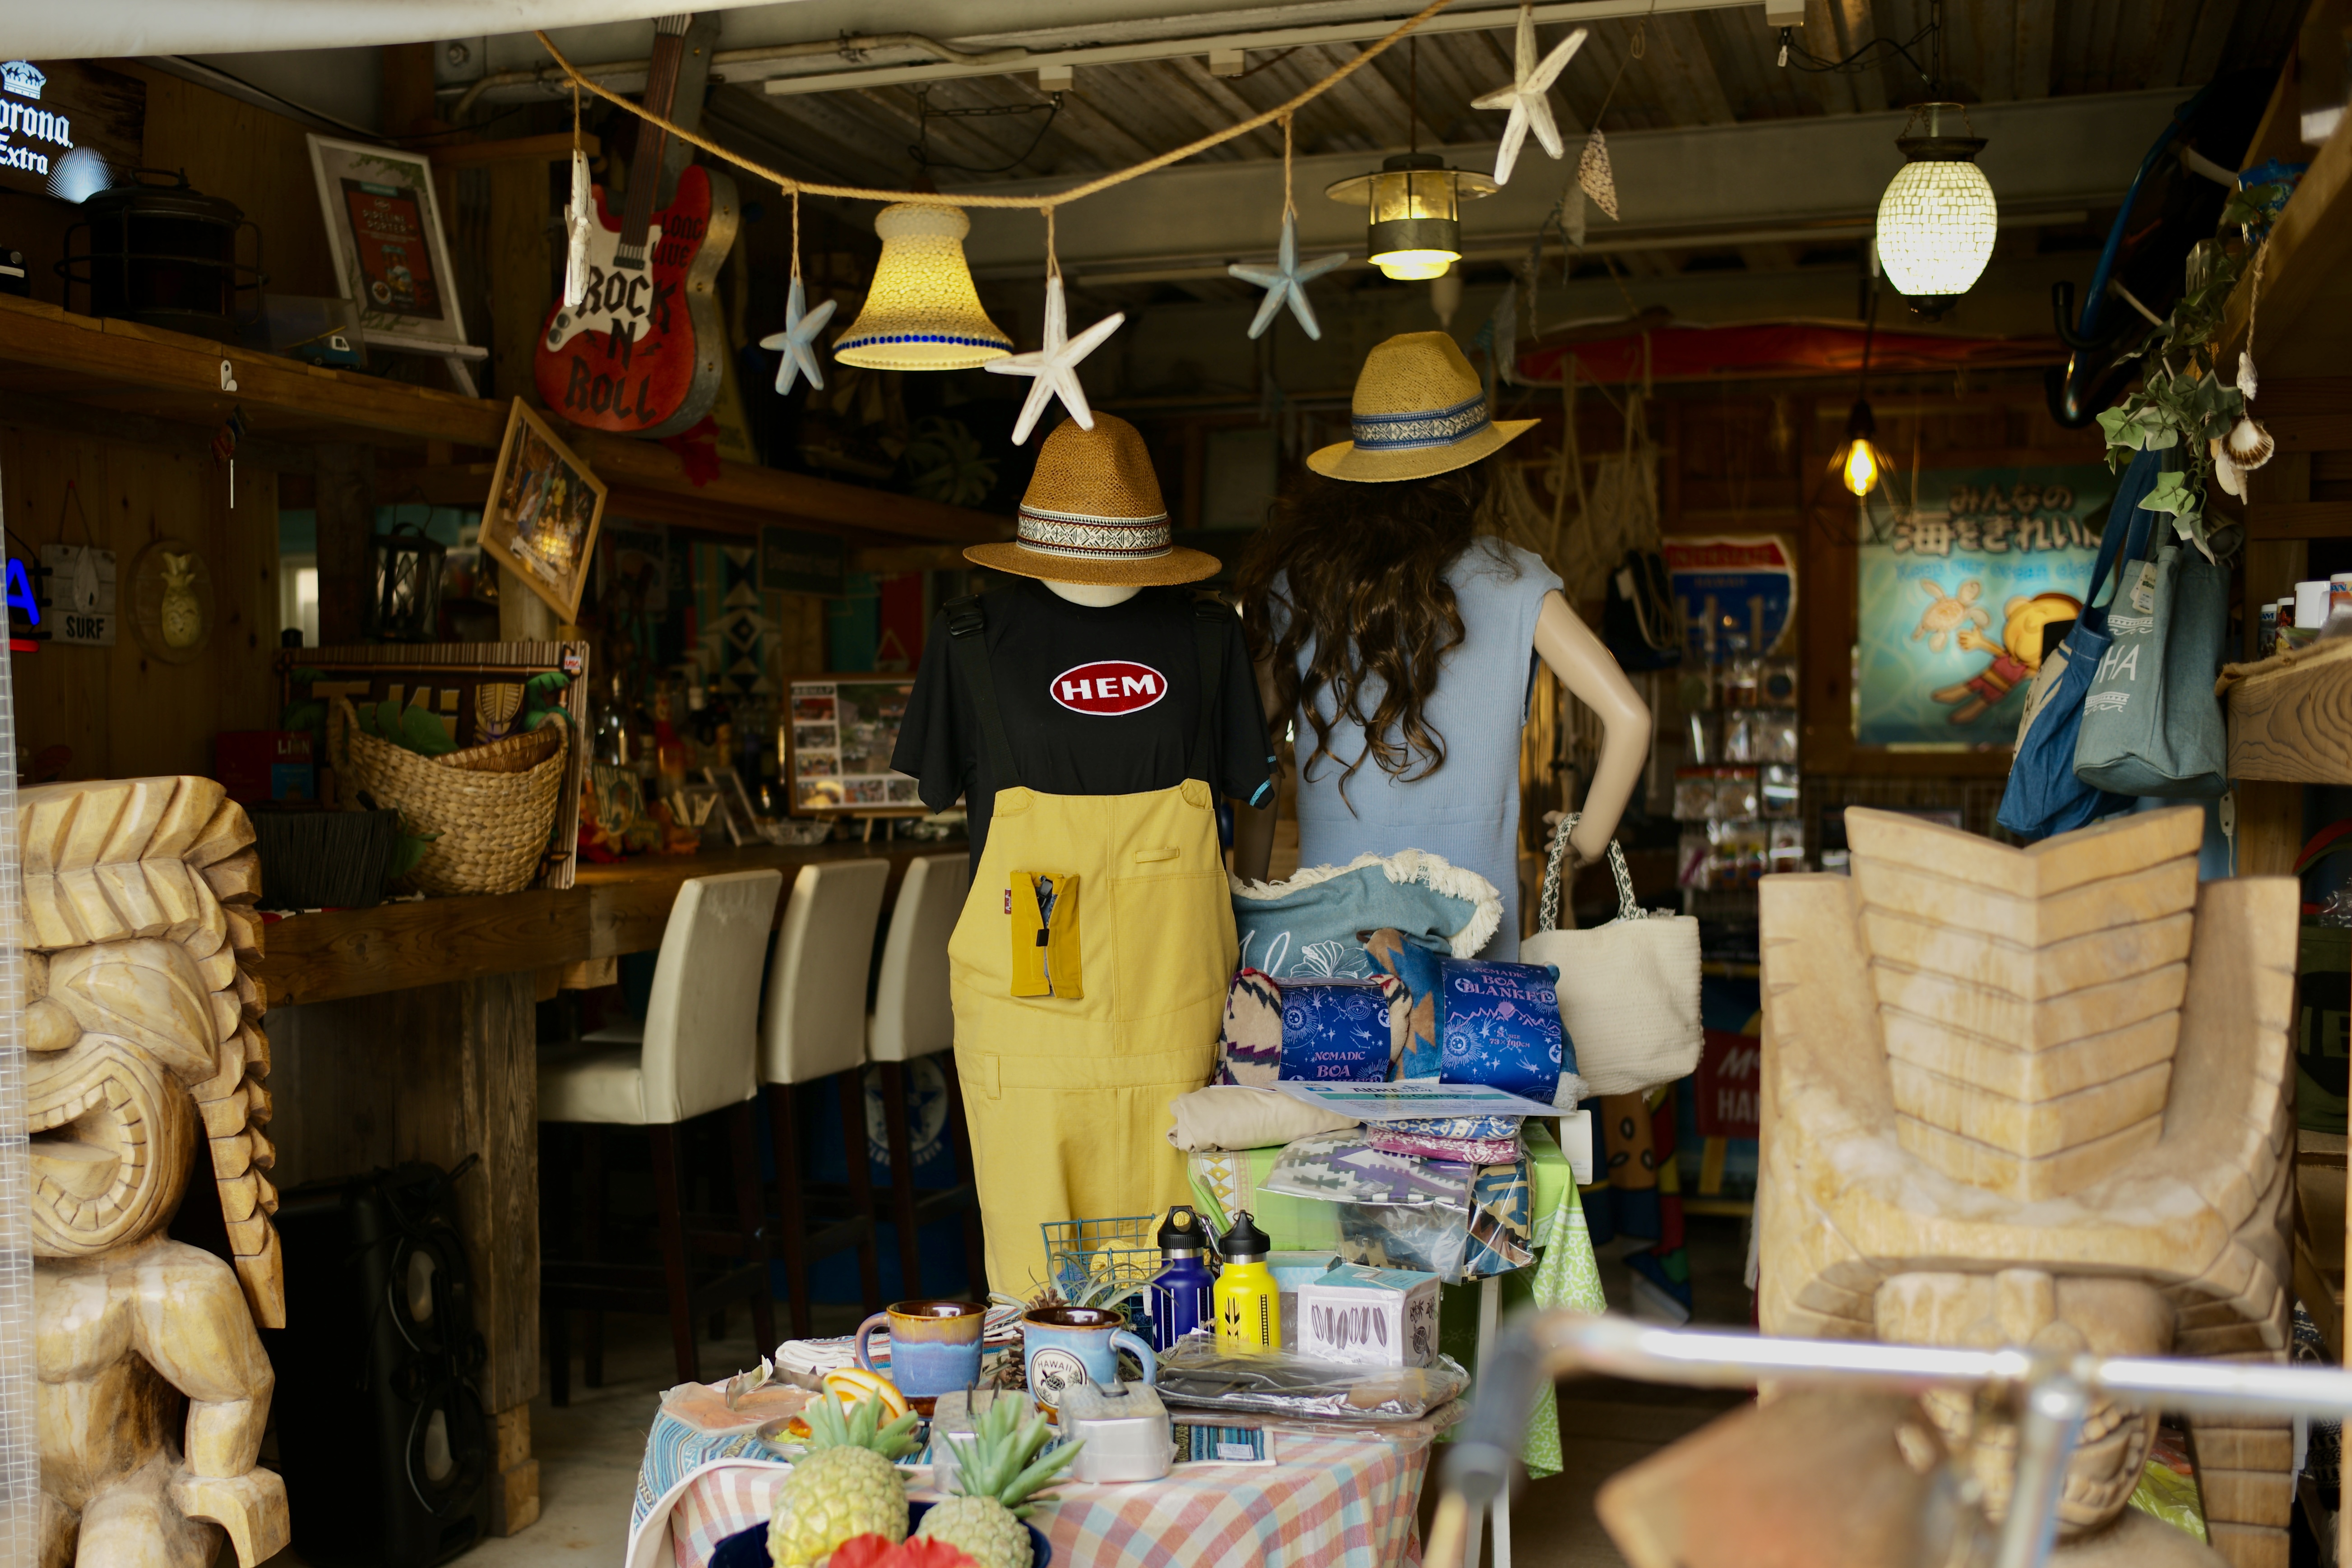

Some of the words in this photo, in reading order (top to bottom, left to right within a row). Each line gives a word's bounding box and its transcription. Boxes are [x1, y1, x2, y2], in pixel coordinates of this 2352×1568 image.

[0, 98, 74, 149] orona.
[662, 214, 703, 240] LONG
[650, 241, 690, 268] LIVE
[575, 265, 676, 334] ROCK
[607, 318, 636, 371] N
[565, 355, 656, 424] ROLL
[66, 615, 104, 638] SURF
[1061, 674, 1157, 700] HEM
[1474, 967, 1528, 979] NOMADIC
[1481, 975, 1519, 988] BOA
[1462, 982, 1549, 1003] BLANKET
[1314, 1051, 1366, 1060] NOMADIC
[1316, 1065, 1351, 1078] BOA
[1717, 1087, 1760, 1125] HA
[1037, 1360, 1072, 1372] HAWAII
